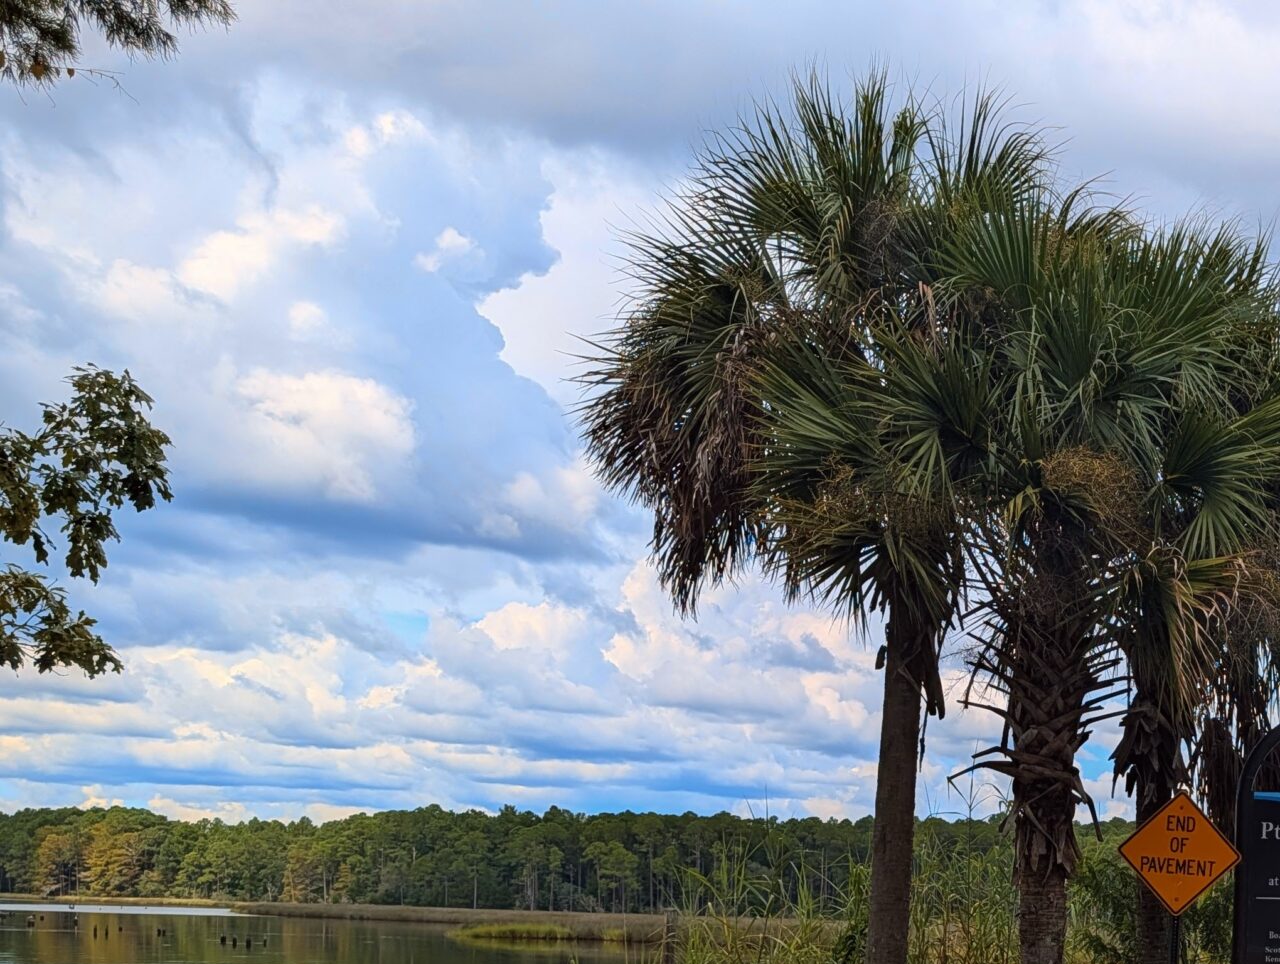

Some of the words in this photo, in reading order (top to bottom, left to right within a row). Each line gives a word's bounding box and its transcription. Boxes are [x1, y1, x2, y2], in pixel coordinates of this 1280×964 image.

[1166, 815, 1196, 832] END
[1170, 837, 1189, 853] OF
[1140, 856, 1216, 877] PAVEMENT
[1268, 877, 1279, 886] at
